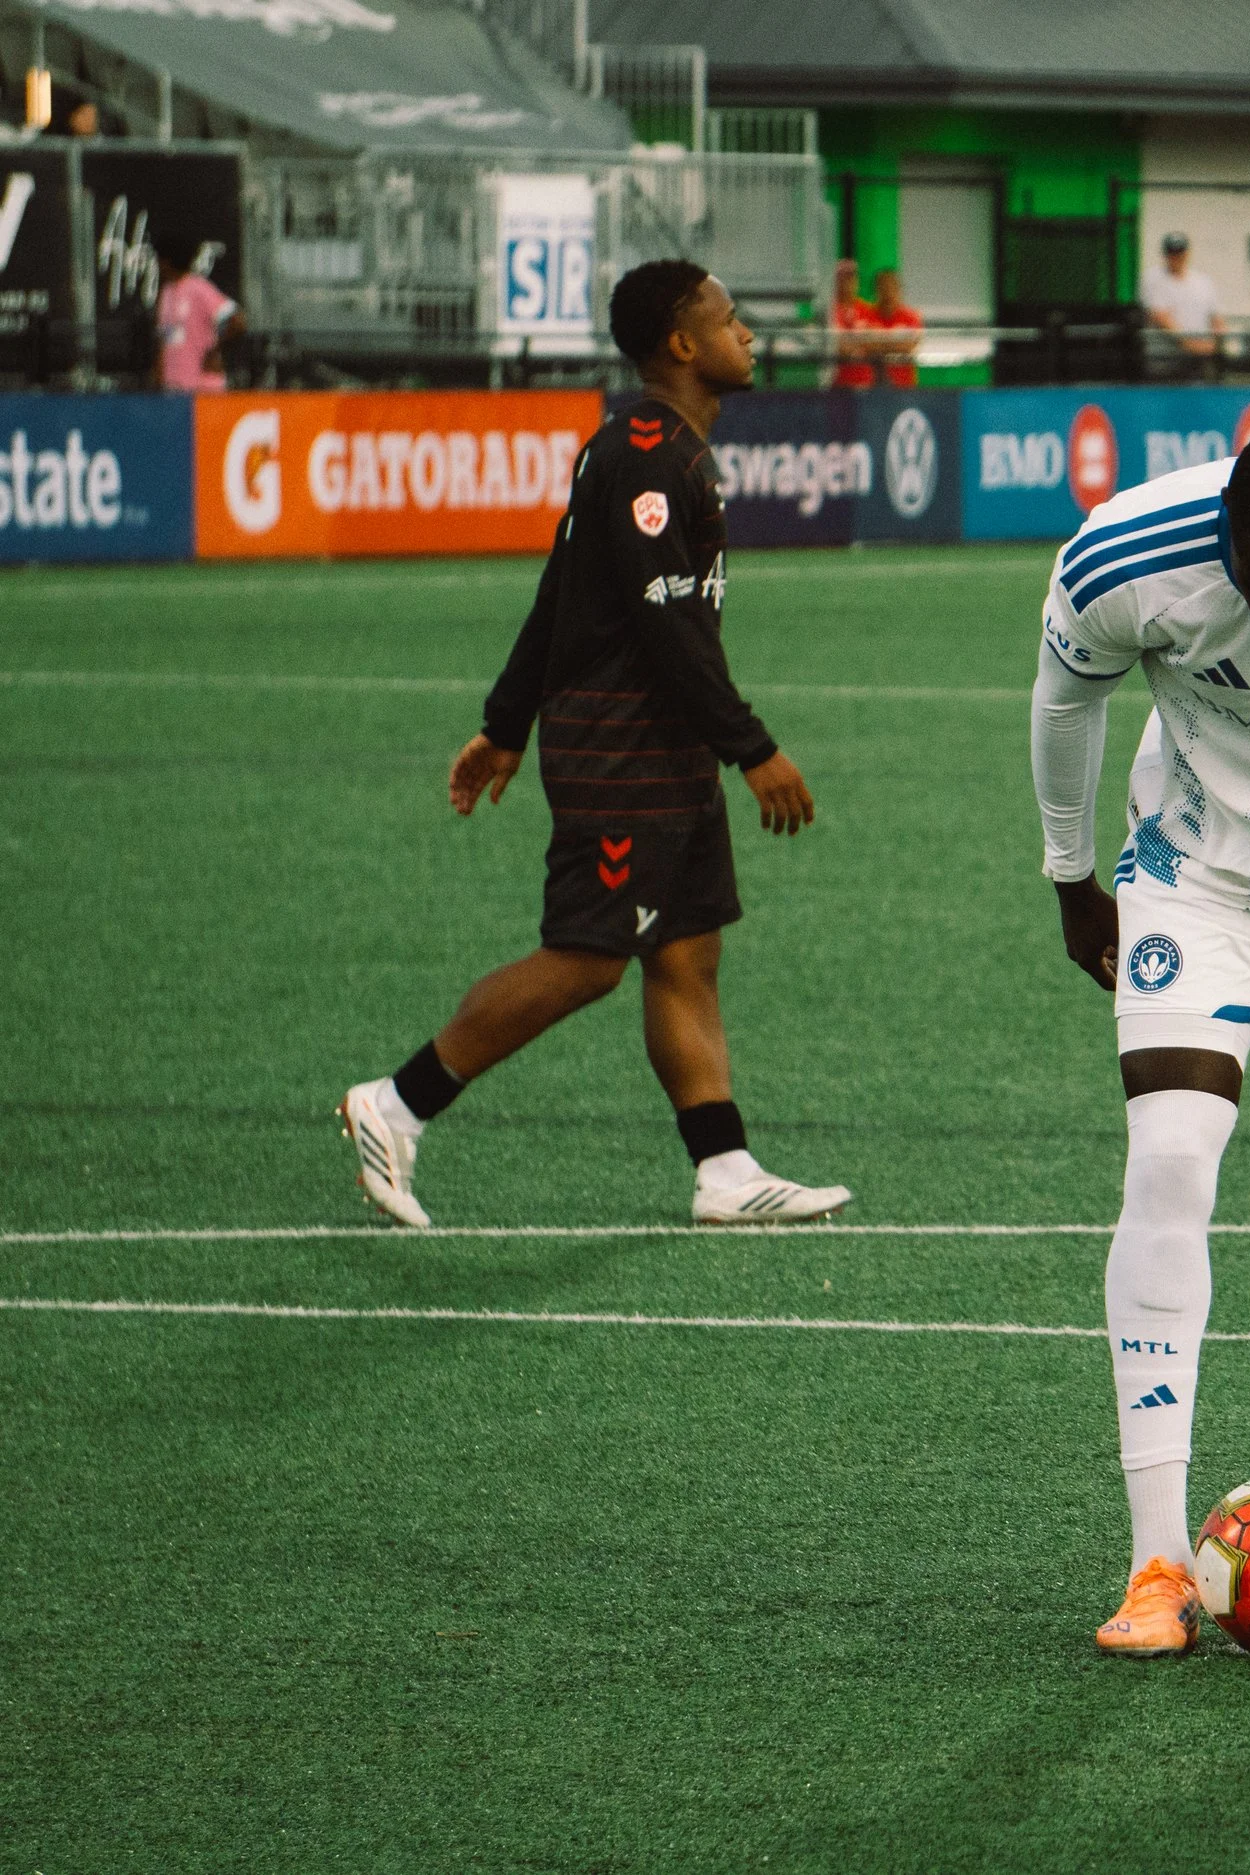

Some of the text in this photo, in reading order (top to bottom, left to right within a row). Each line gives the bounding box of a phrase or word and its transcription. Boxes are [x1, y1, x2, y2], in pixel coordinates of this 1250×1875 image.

[308, 430, 578, 512] GATORADE
[980, 432, 1064, 489] BMO
[1121, 1338, 1178, 1355] MTL
